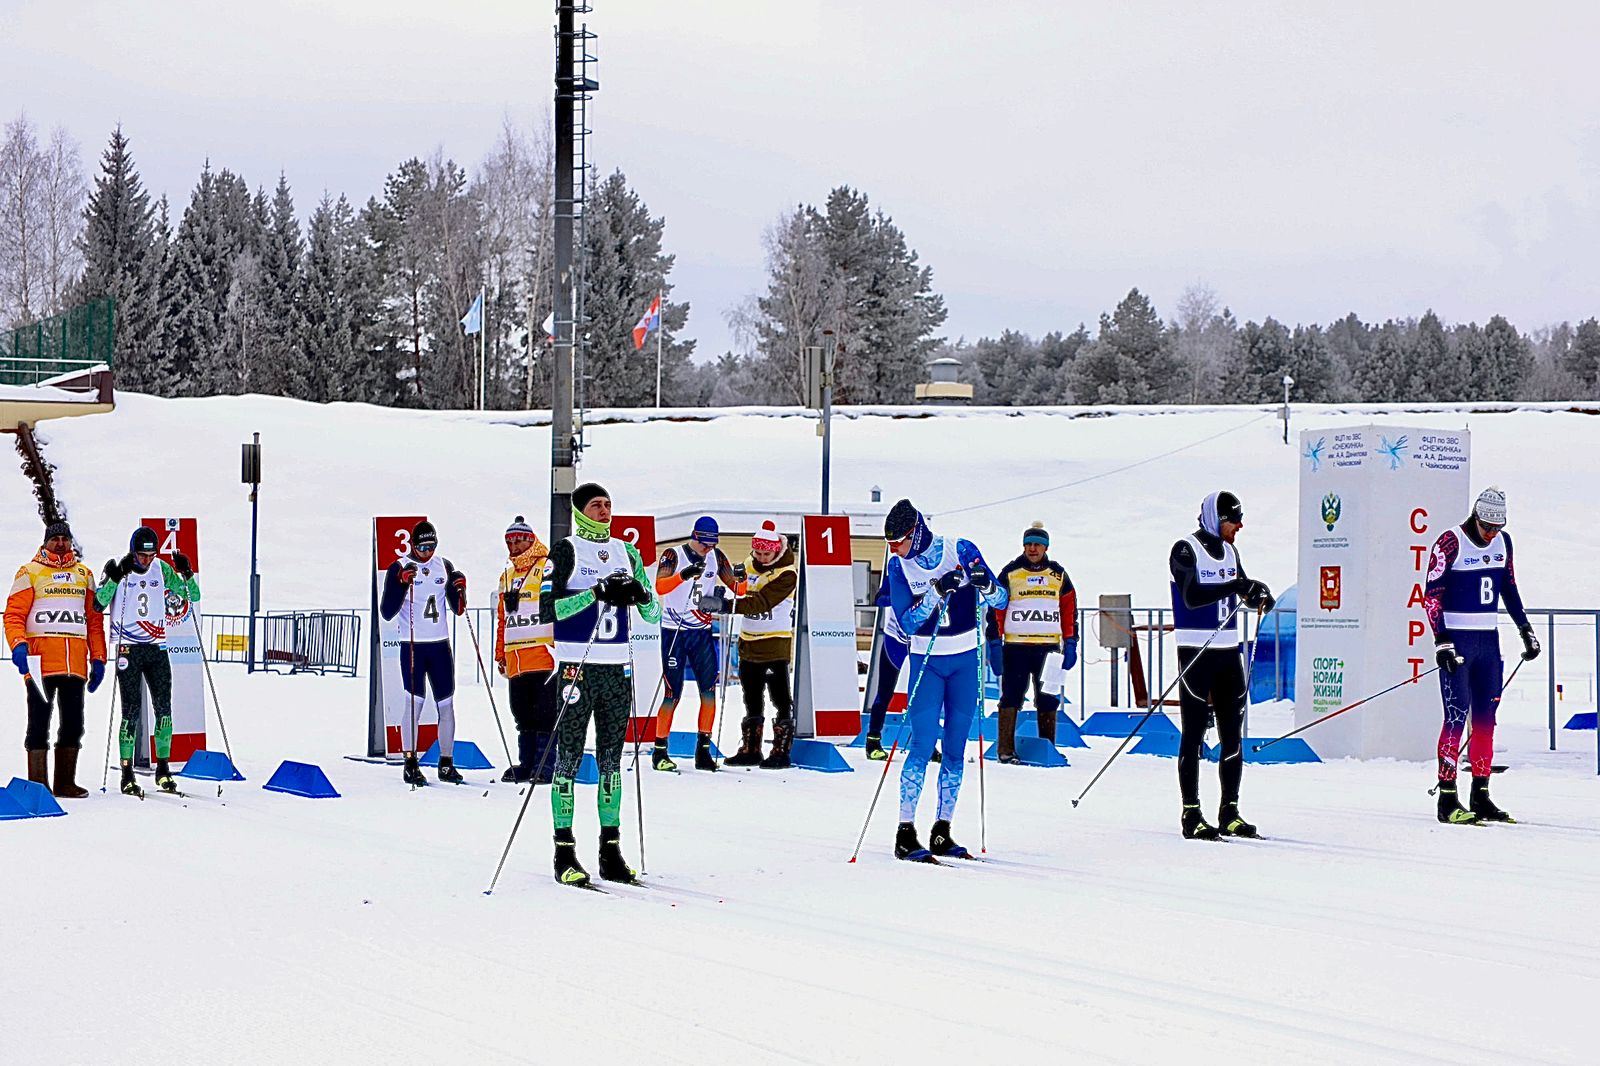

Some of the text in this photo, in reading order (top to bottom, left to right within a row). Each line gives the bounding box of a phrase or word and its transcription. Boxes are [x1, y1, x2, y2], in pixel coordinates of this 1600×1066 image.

[1425, 462, 1459, 470] Чайковский
[1438, 454, 1467, 462] Данилова
[160, 531, 180, 560] 4
[394, 529, 411, 557] 3
[623, 528, 640, 551] 2
[821, 528, 833, 554] 1
[692, 583, 703, 606] 5
[1407, 508, 1428, 684] СТАРТ
[1480, 577, 1494, 604] B
[138, 593, 148, 617] 3
[424, 594, 439, 623] 4
[1012, 609, 1059, 622] СУДЬЯ
[168, 646, 201, 654] KOVSKIY
[1313, 657, 1338, 670] СПОРТ
[1313, 671, 1343, 684] НОРМА
[1313, 685, 1342, 697] ЖИЗНИ
